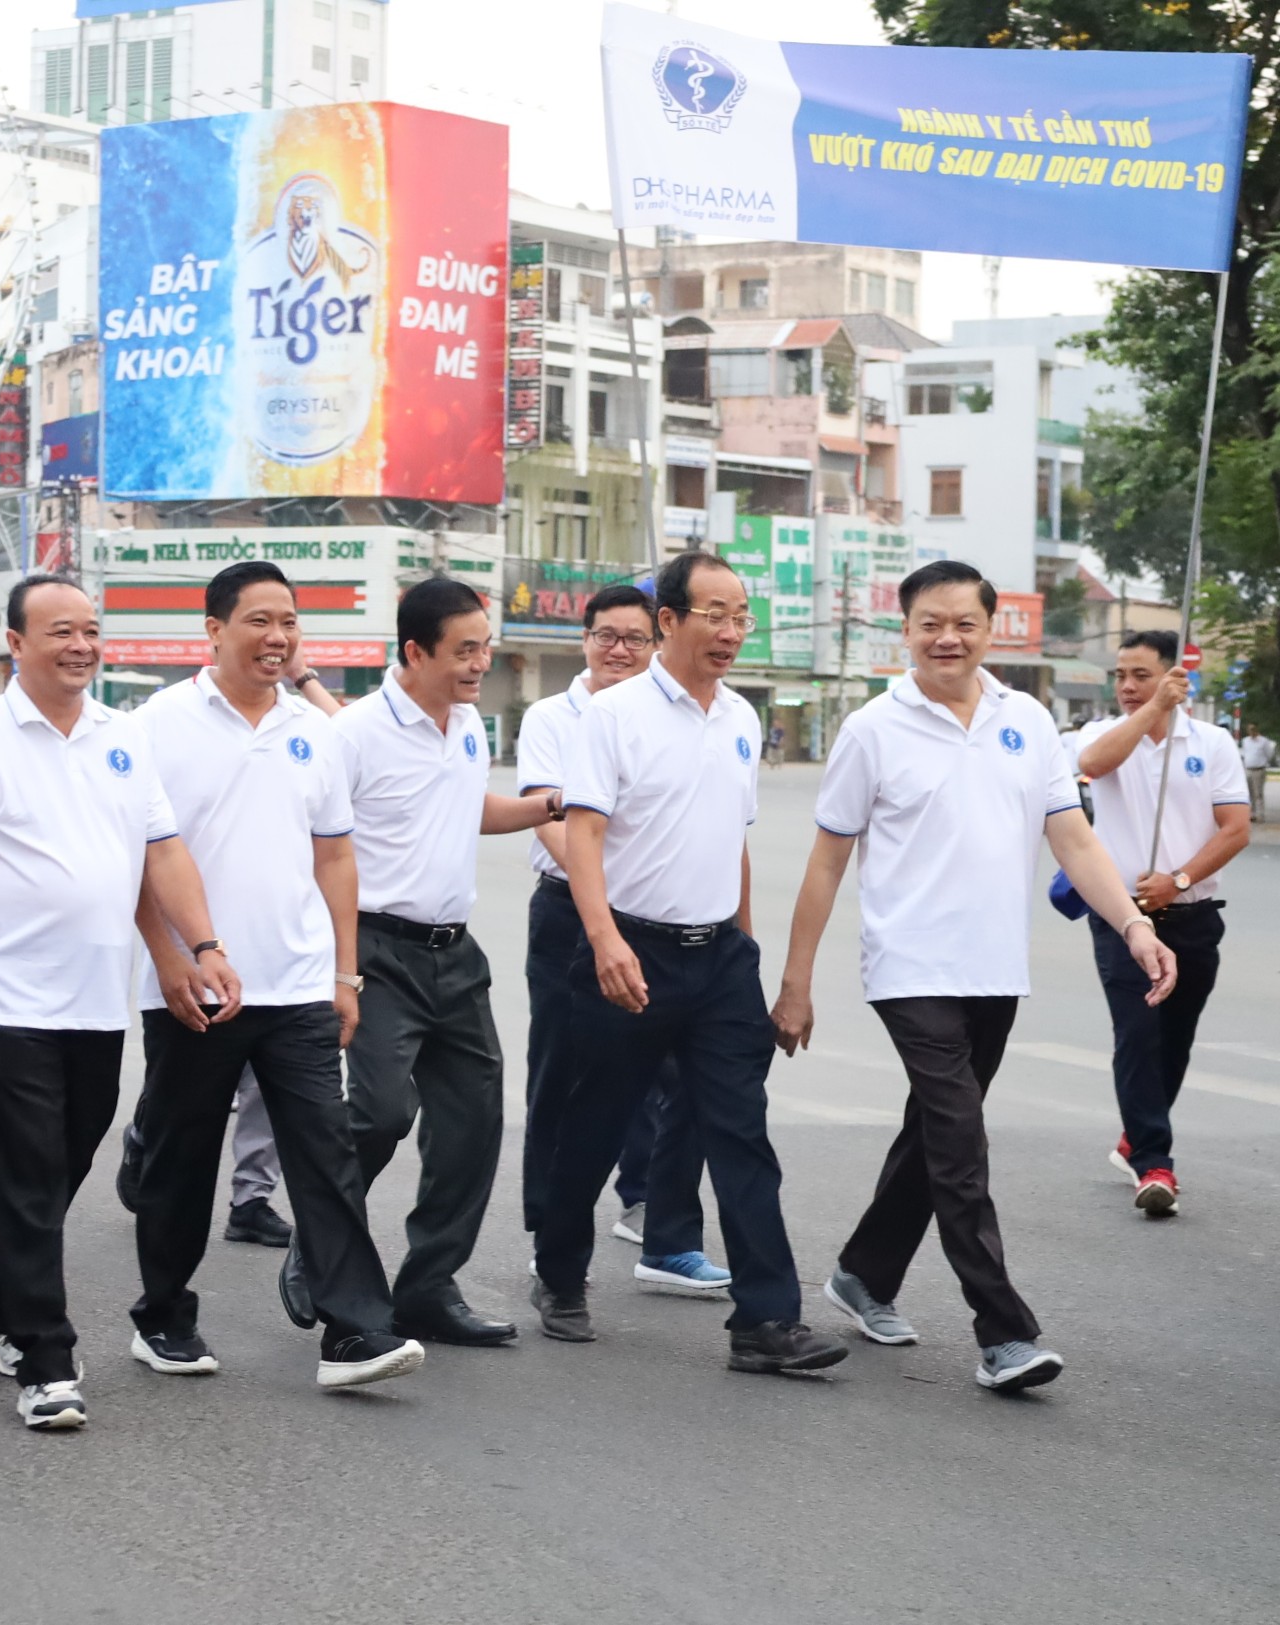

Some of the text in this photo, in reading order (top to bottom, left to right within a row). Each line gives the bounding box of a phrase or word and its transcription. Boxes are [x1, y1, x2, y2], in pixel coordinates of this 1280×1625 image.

[897, 106, 1153, 149] NGÀNH Y TẾ CẦN THƠ
[809, 131, 1225, 193] VƯỢT KHÓ SAU ĐẠI DỊCH COVID-19
[673, 182, 776, 211] PHARMA
[149, 252, 219, 301] BẬT
[417, 250, 499, 297] BÙNG
[103, 295, 198, 340] SẢNG
[248, 276, 372, 365] Tiger
[399, 296, 468, 335] ĐAM
[114, 336, 225, 381] KHOÁI
[434, 339, 480, 380] MÊ
[267, 397, 342, 416] CRYSTAL
[153, 537, 190, 561] NHÀ
[261, 541, 322, 560] TRUNG
